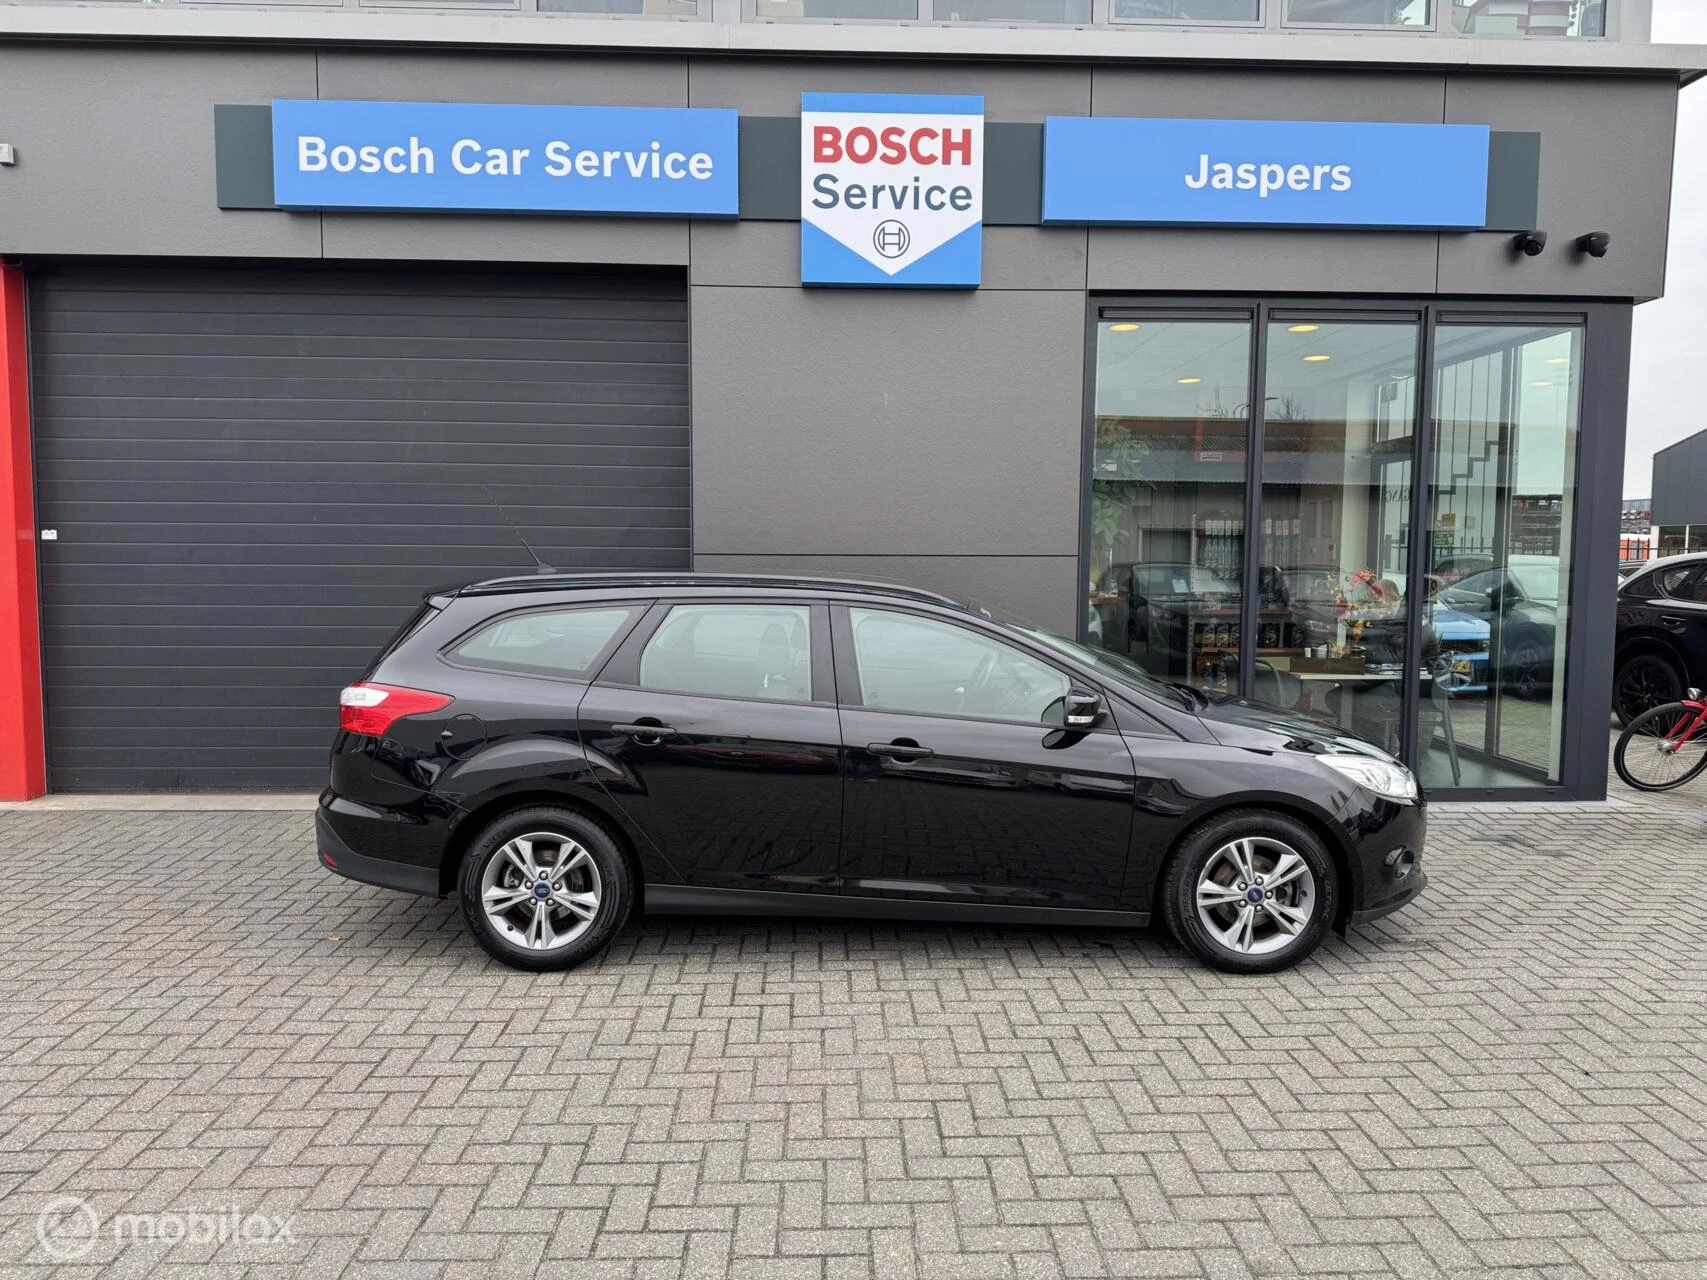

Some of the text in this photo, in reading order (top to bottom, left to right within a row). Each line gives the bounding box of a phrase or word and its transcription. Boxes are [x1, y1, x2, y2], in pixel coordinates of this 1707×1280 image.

[297, 136, 713, 180] Bosch Car Service
[813, 125, 973, 166] BOSCH
[812, 173, 973, 211] Service
[1184, 153, 1352, 198] Jaspers
